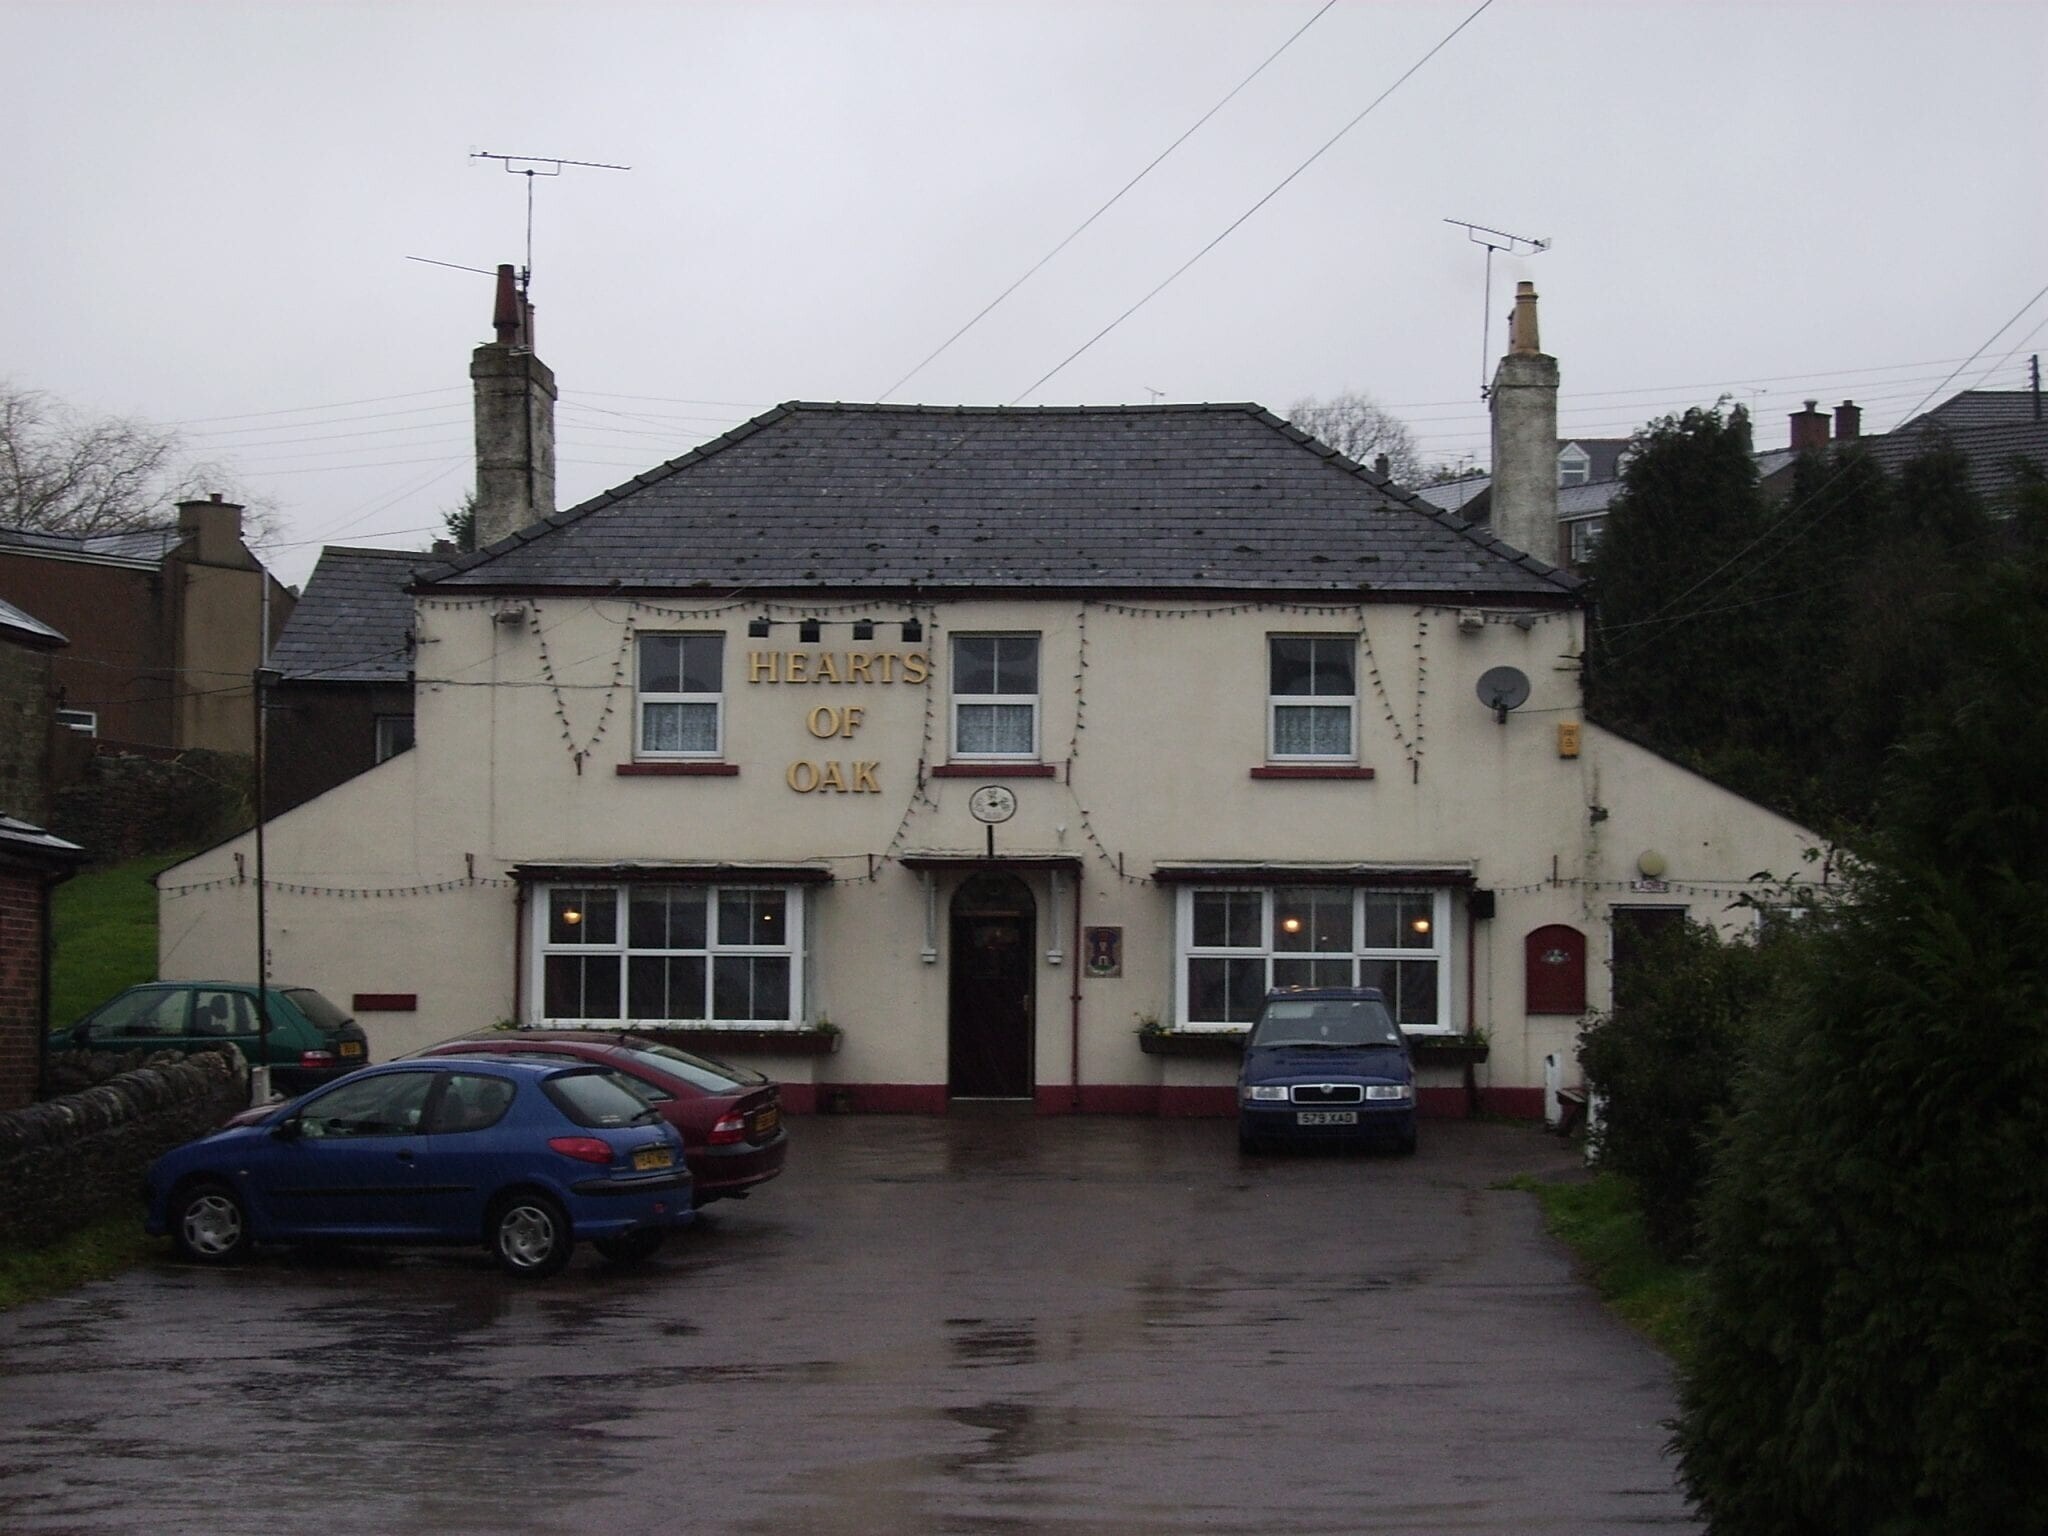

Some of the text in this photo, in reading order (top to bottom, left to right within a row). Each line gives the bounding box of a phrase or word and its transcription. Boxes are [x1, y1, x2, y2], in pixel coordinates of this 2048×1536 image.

[748, 651, 929, 684] HEARTS
[807, 705, 865, 738] OF
[787, 760, 881, 793] OAK
